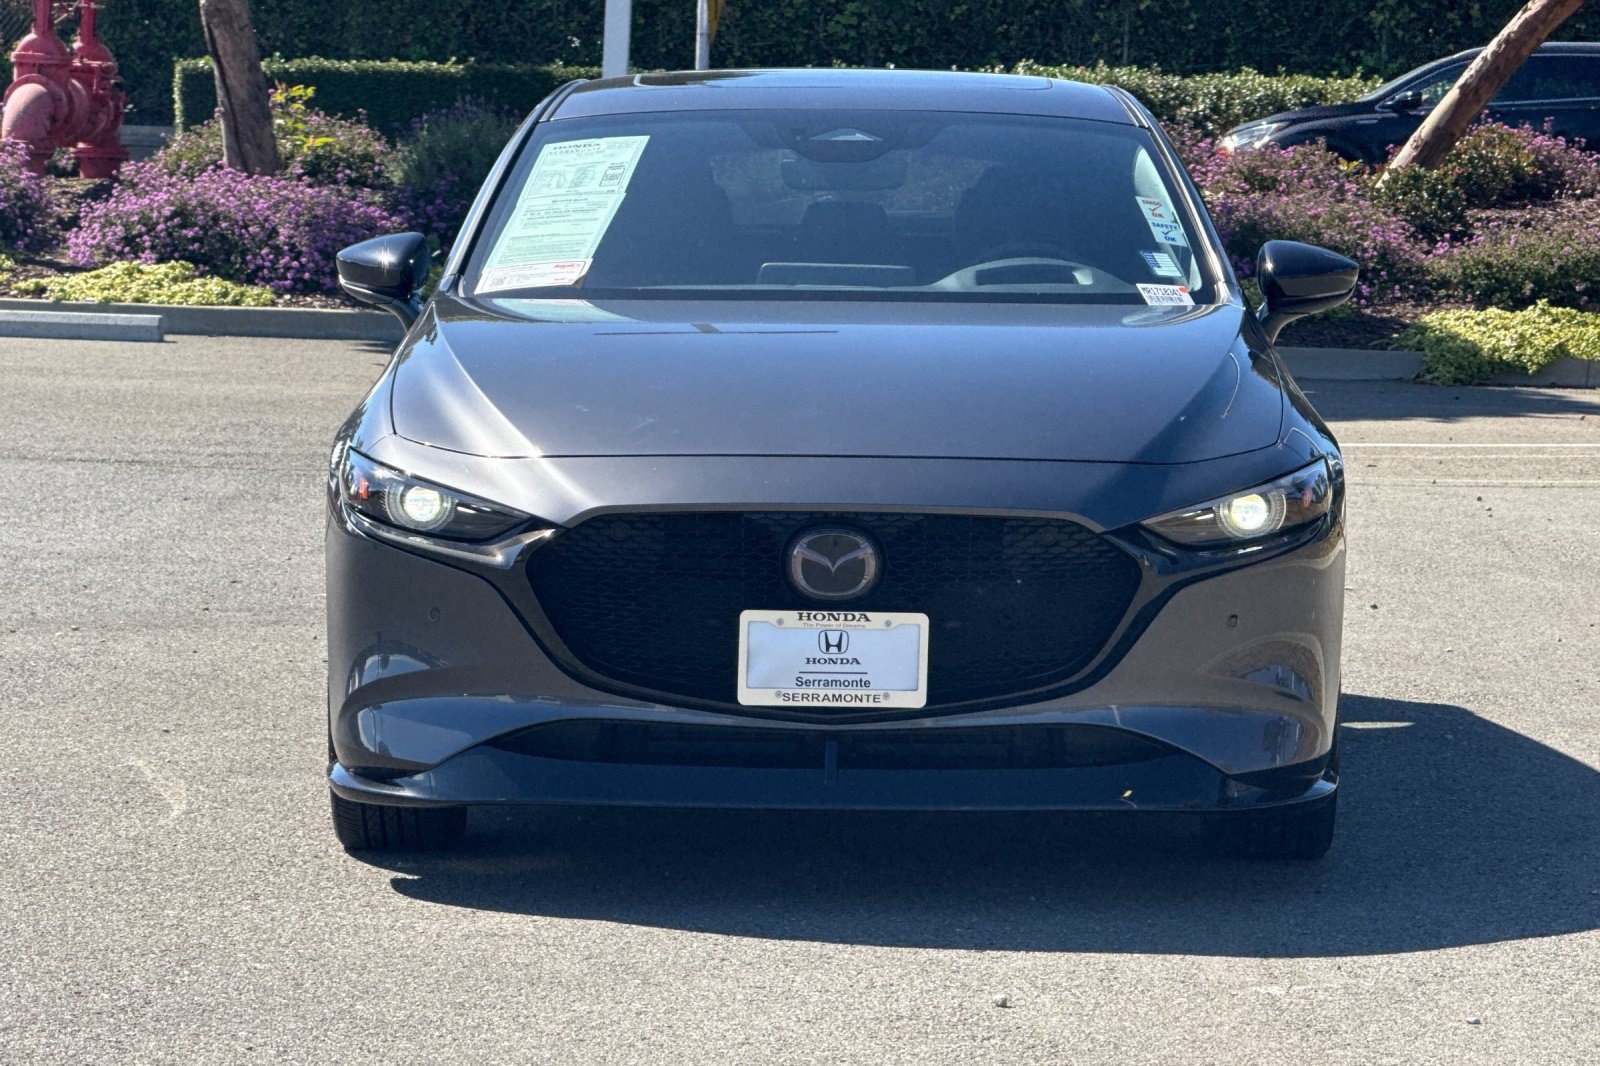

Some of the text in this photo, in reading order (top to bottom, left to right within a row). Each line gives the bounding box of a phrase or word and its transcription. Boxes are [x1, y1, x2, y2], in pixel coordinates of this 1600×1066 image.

[1151, 221, 1178, 230] SAFETY
[797, 611, 872, 623] HONDA
[805, 657, 862, 665] HONDA
[795, 676, 871, 688] Serramonte
[782, 692, 882, 703] SERRAMONTE
